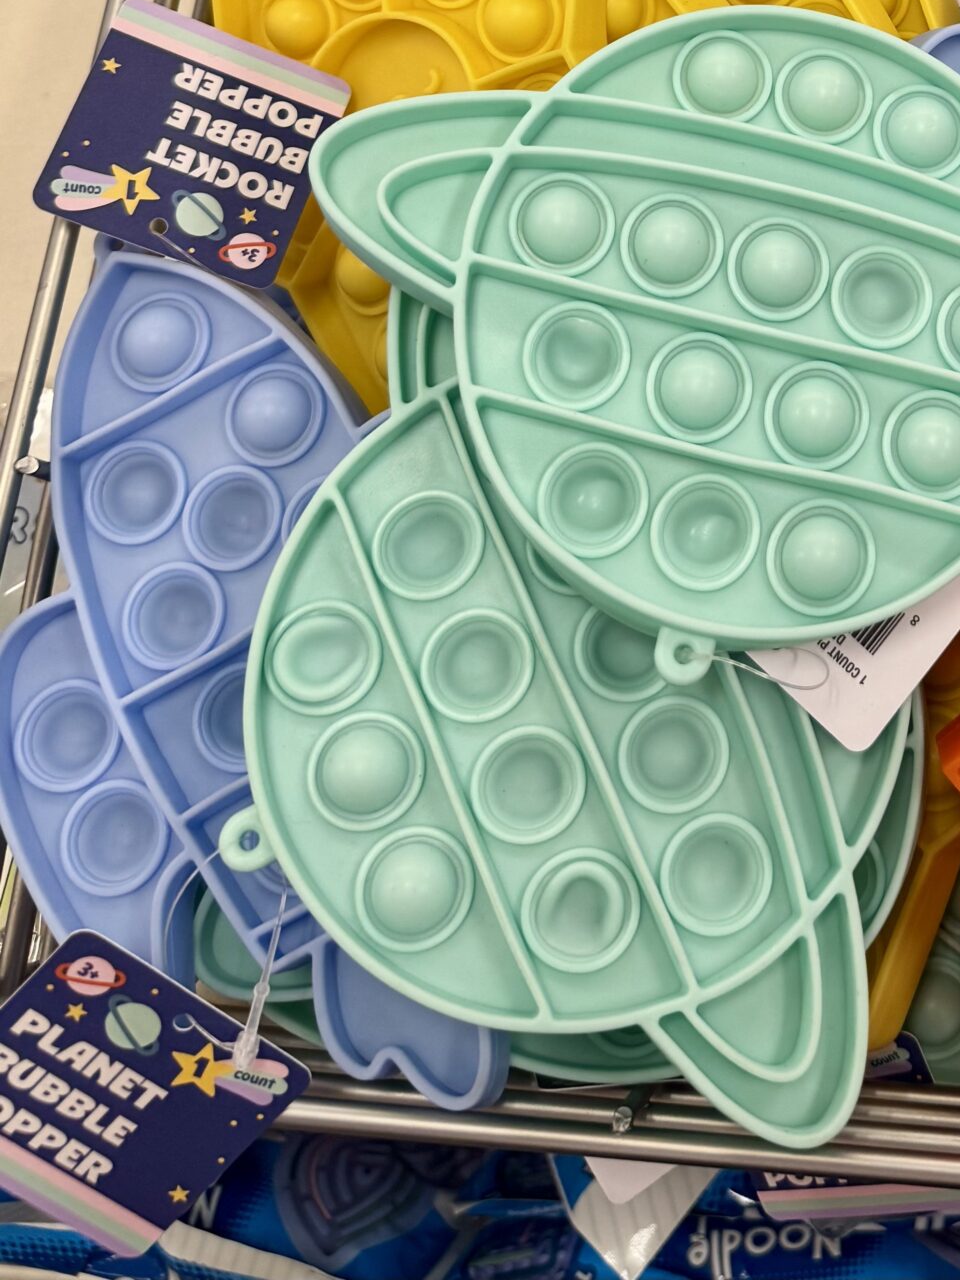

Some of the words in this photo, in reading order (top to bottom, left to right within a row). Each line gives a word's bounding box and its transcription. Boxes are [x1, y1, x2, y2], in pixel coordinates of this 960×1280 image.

[173, 62, 324, 139] POPPER
[165, 100, 311, 175] BUBBLE
[146, 137, 296, 210] ROCKET
[63, 182, 102, 195] count
[125, 179, 139, 200] 1
[241, 247, 260, 263] 3+
[910, 615, 920, 626] 8
[827, 646, 861, 679] COUNT
[77, 962, 99, 979] 3+
[10, 1008, 169, 1110] PLANET
[234, 1070, 276, 1089] count
